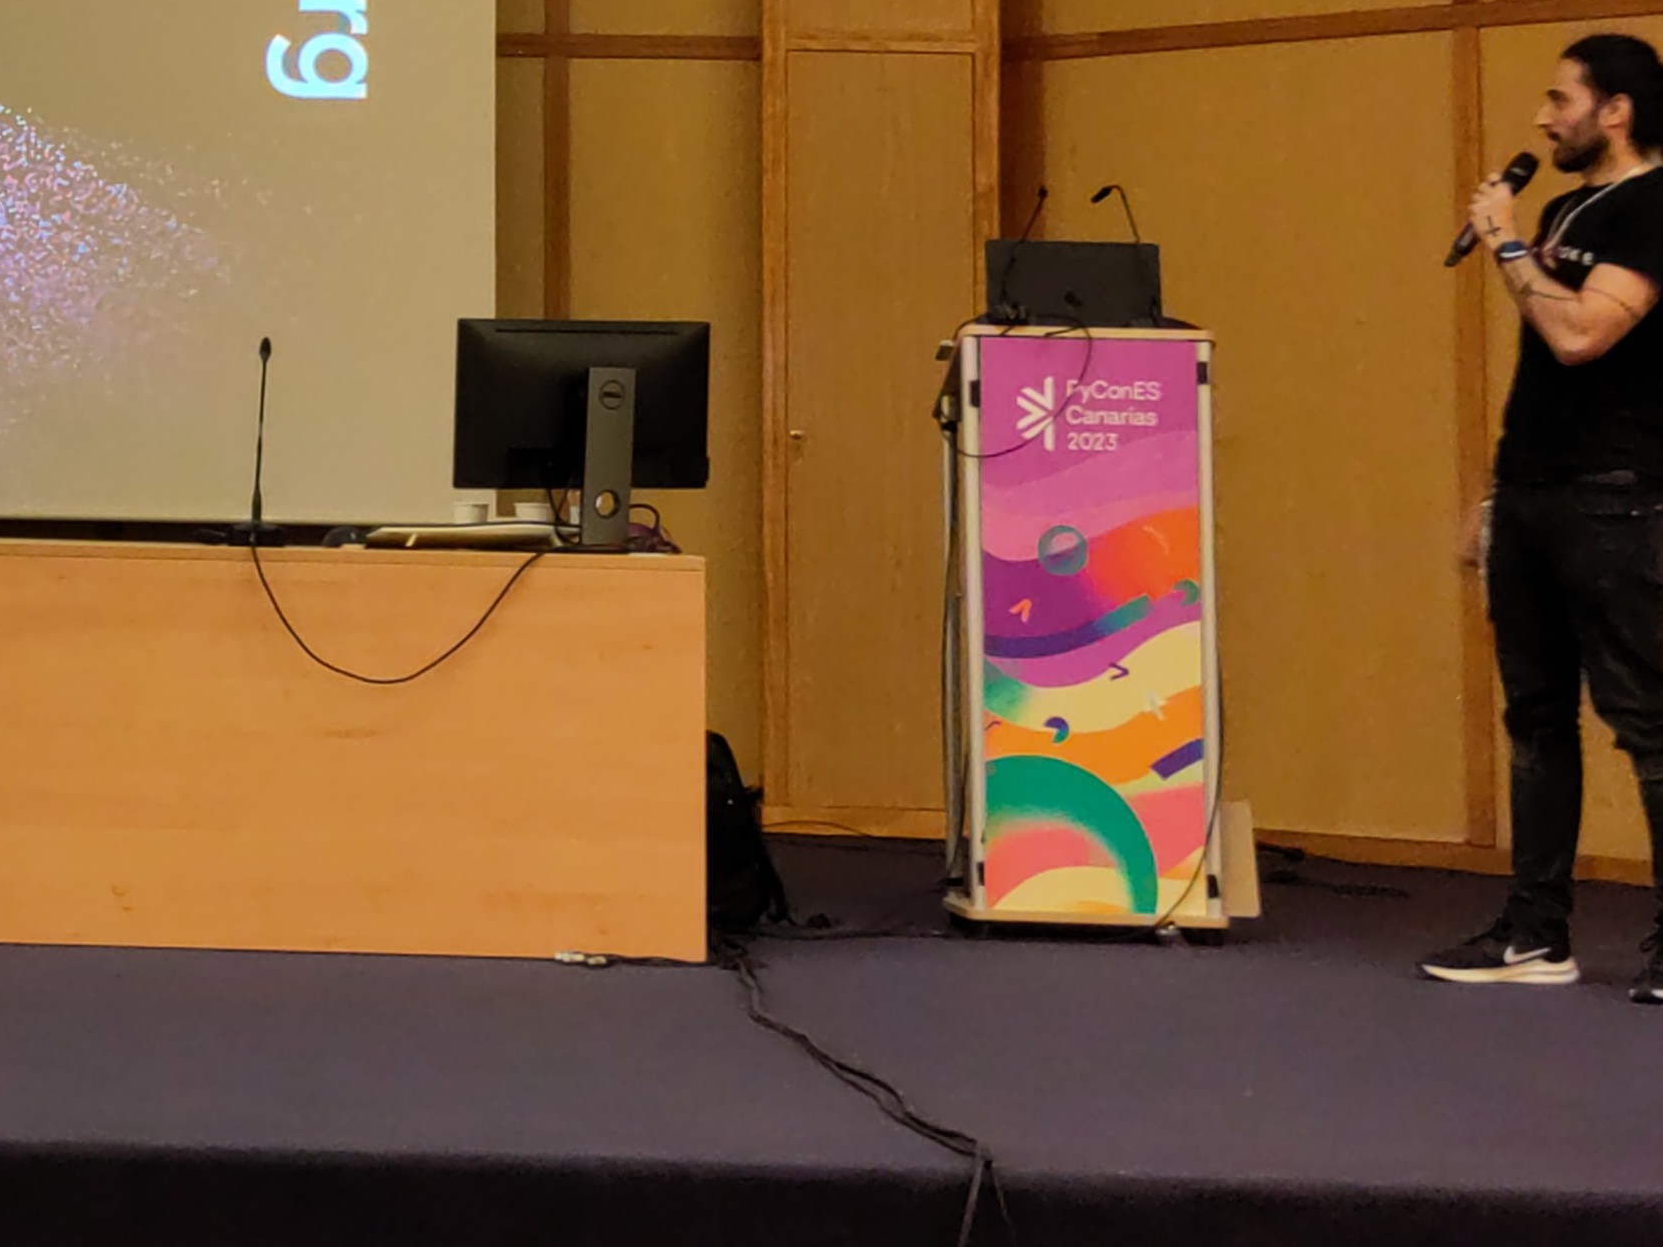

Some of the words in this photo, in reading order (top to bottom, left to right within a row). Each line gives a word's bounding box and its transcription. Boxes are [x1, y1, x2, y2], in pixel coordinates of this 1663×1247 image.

[1066, 379, 1162, 404] PyConES
[1065, 405, 1158, 427] Canarias
[1066, 432, 1118, 451] 2023
